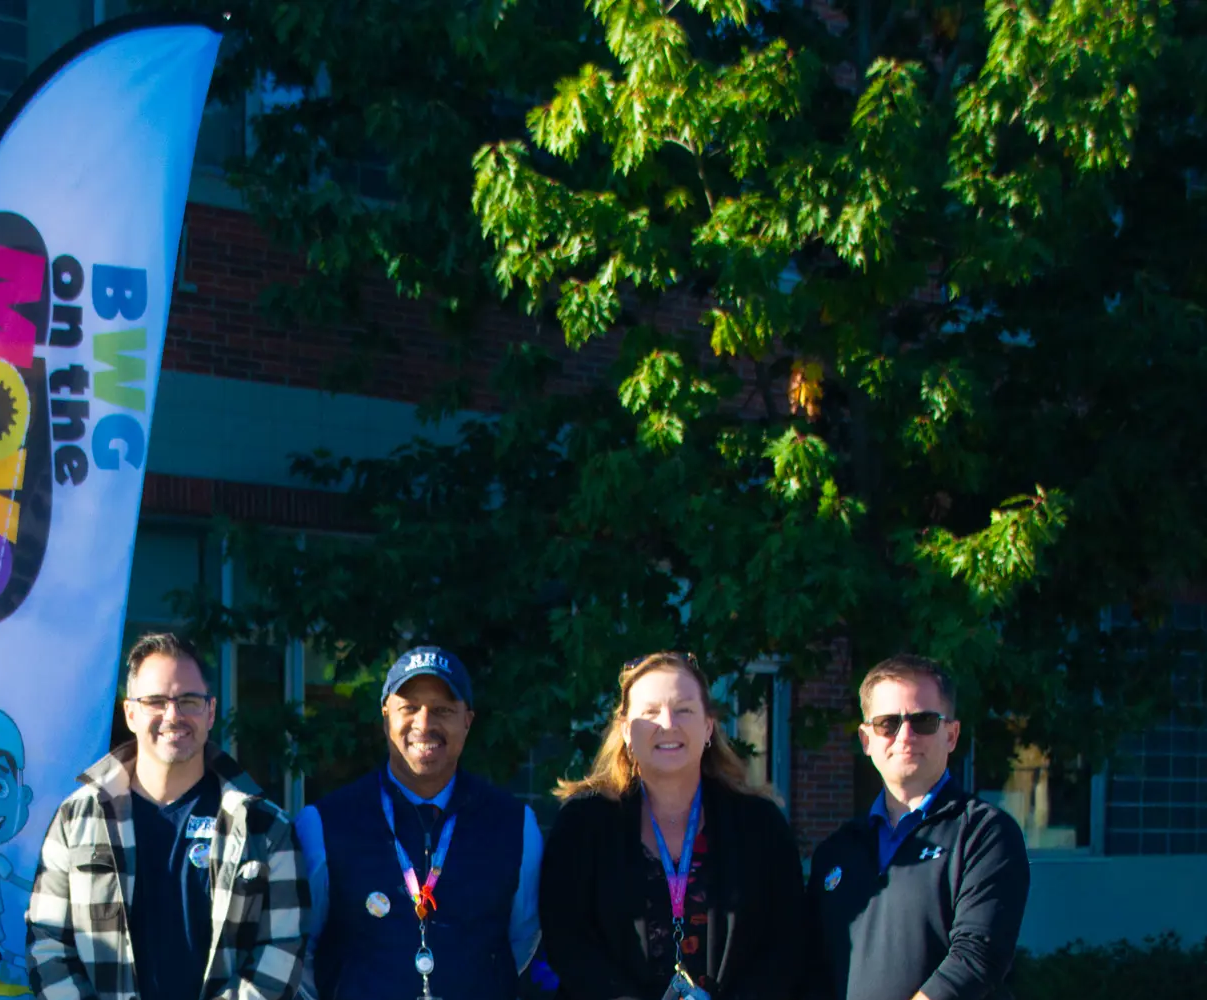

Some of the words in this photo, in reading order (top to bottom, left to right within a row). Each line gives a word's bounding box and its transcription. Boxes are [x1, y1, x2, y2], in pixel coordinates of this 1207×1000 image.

[48, 254, 85, 348] on
[49, 364, 90, 487] the
[92, 263, 148, 471] BWG
